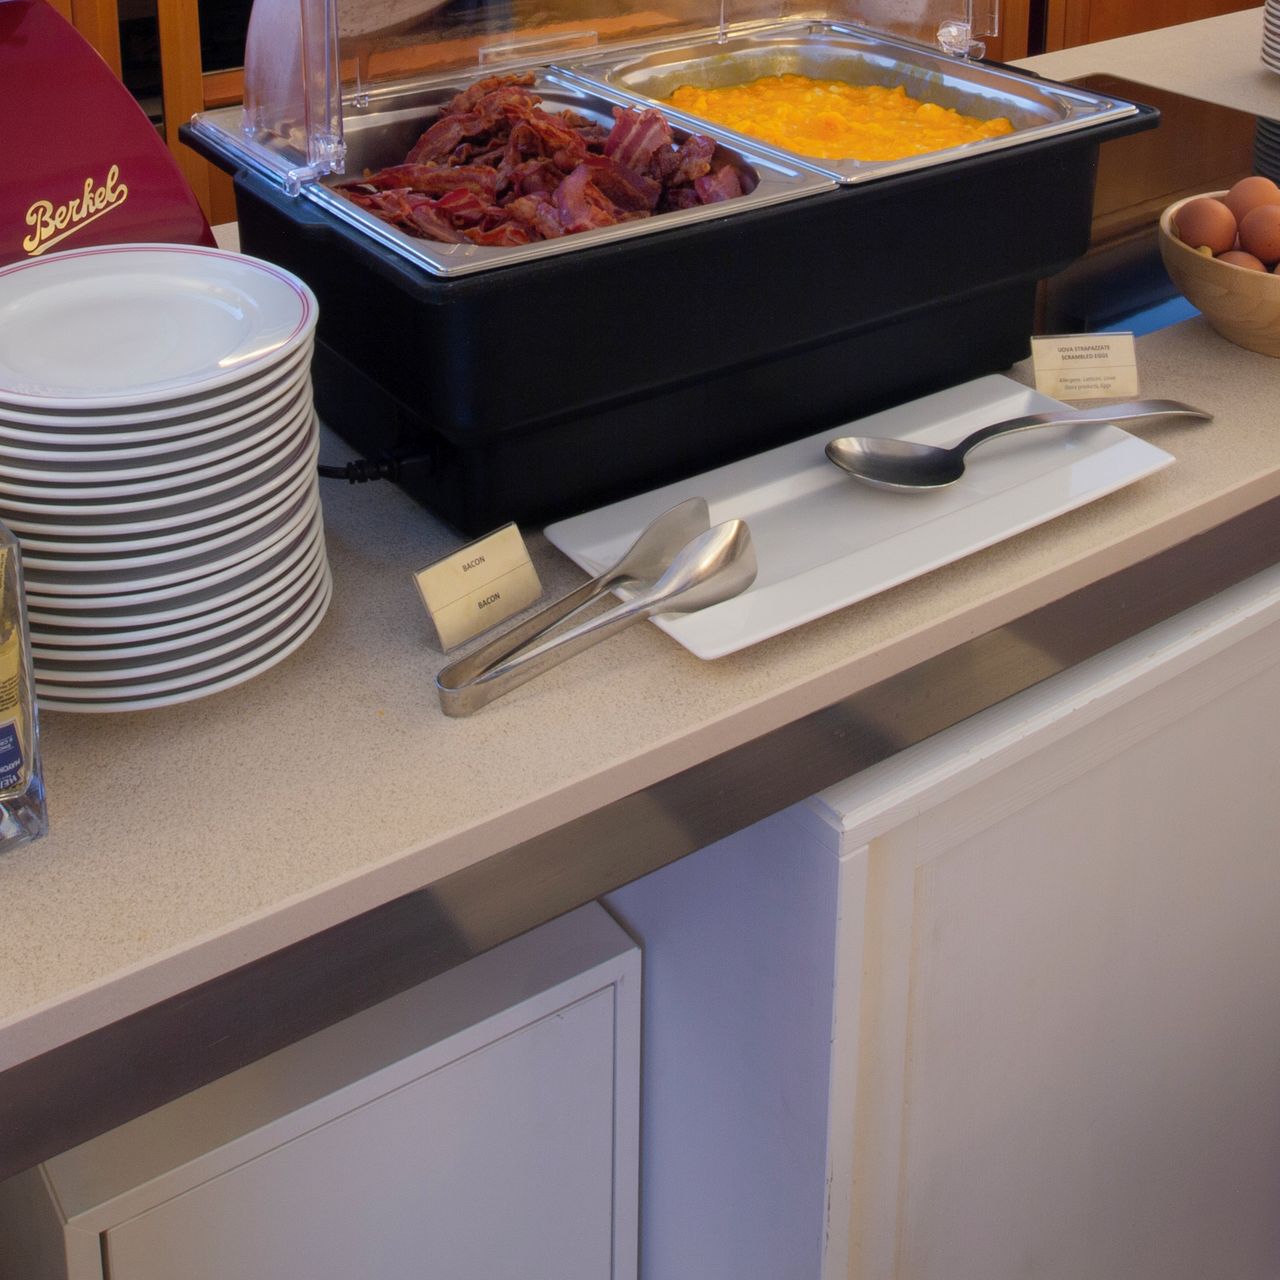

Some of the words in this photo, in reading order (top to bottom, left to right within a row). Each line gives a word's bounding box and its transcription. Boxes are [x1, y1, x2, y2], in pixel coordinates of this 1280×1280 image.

[22, 164, 129, 256] Berkel
[1074, 344, 1110, 352] STRAPAZZATE
[462, 555, 486, 572] BACON
[477, 591, 501, 609] BACON
